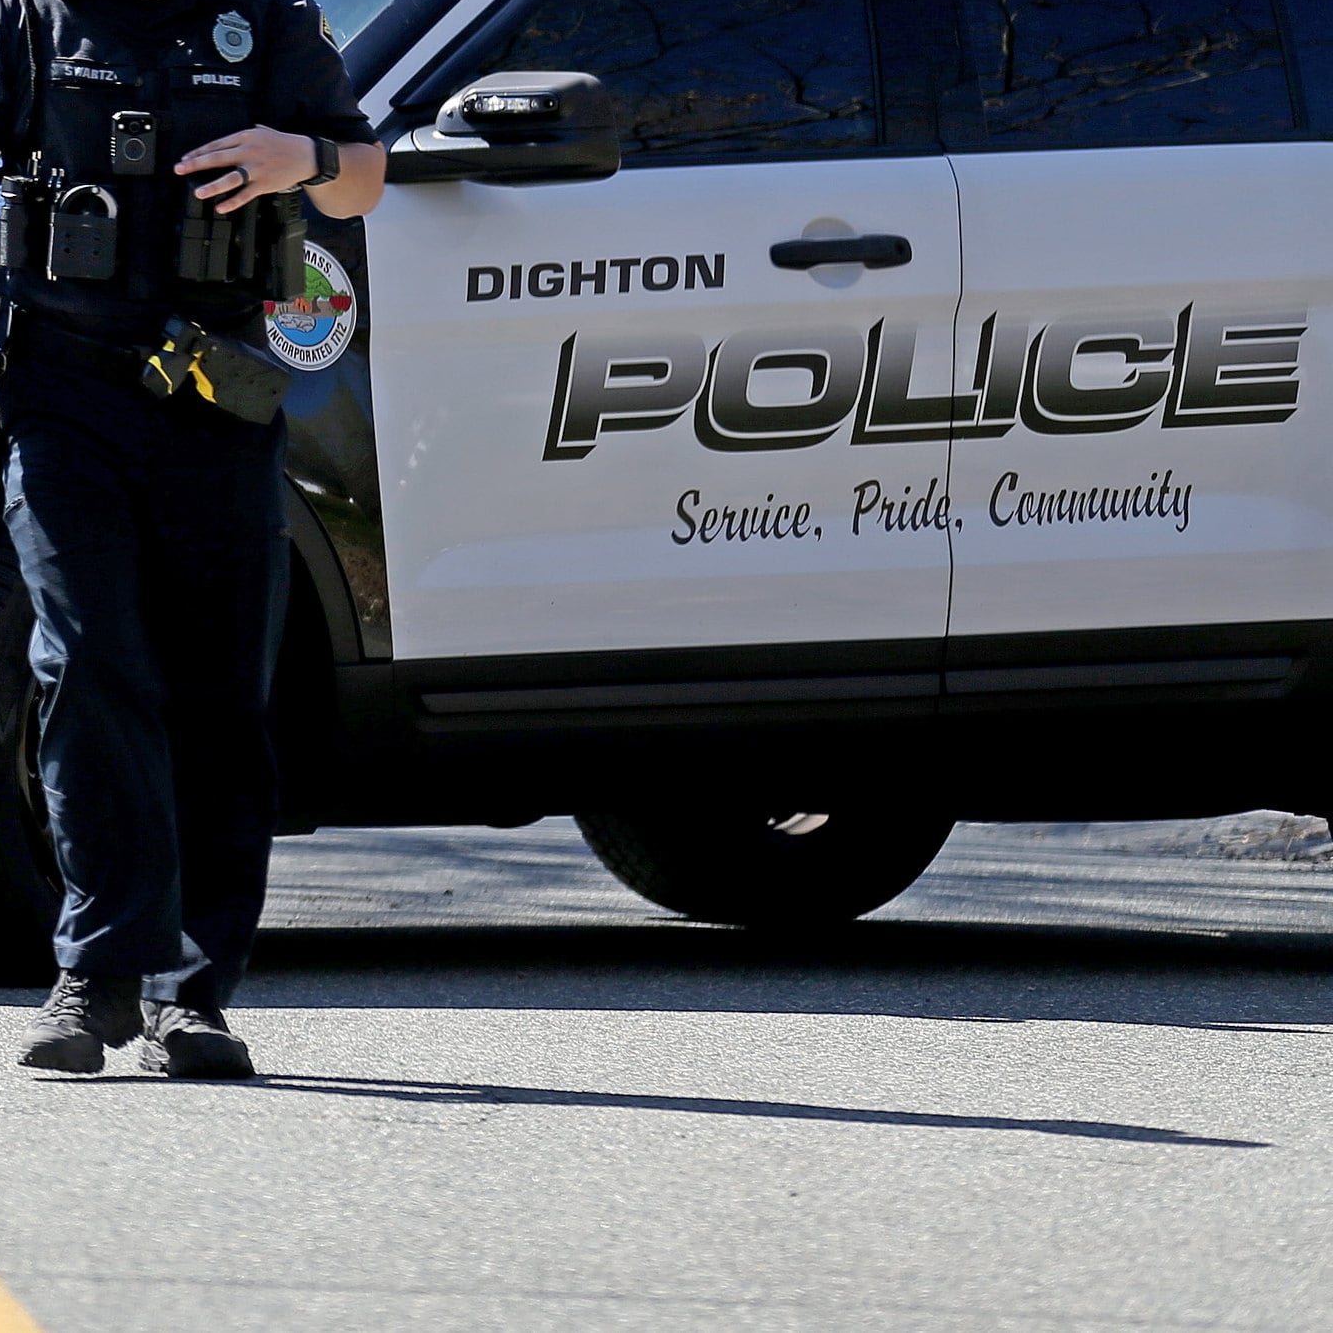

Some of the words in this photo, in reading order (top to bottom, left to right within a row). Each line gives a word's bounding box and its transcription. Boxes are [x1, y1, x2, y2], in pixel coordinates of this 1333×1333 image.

[64, 65, 114, 81] SWARTZ
[192, 73, 241, 86] POLICE
[467, 253, 726, 302] DIGHTON
[268, 327, 333, 363] INCORPORATED
[330, 322, 347, 346] 1712
[542, 300, 1308, 462] POLICE
[671, 490, 823, 545] Service,
[852, 478, 963, 535] Pride,
[988, 469, 1193, 533] Community
